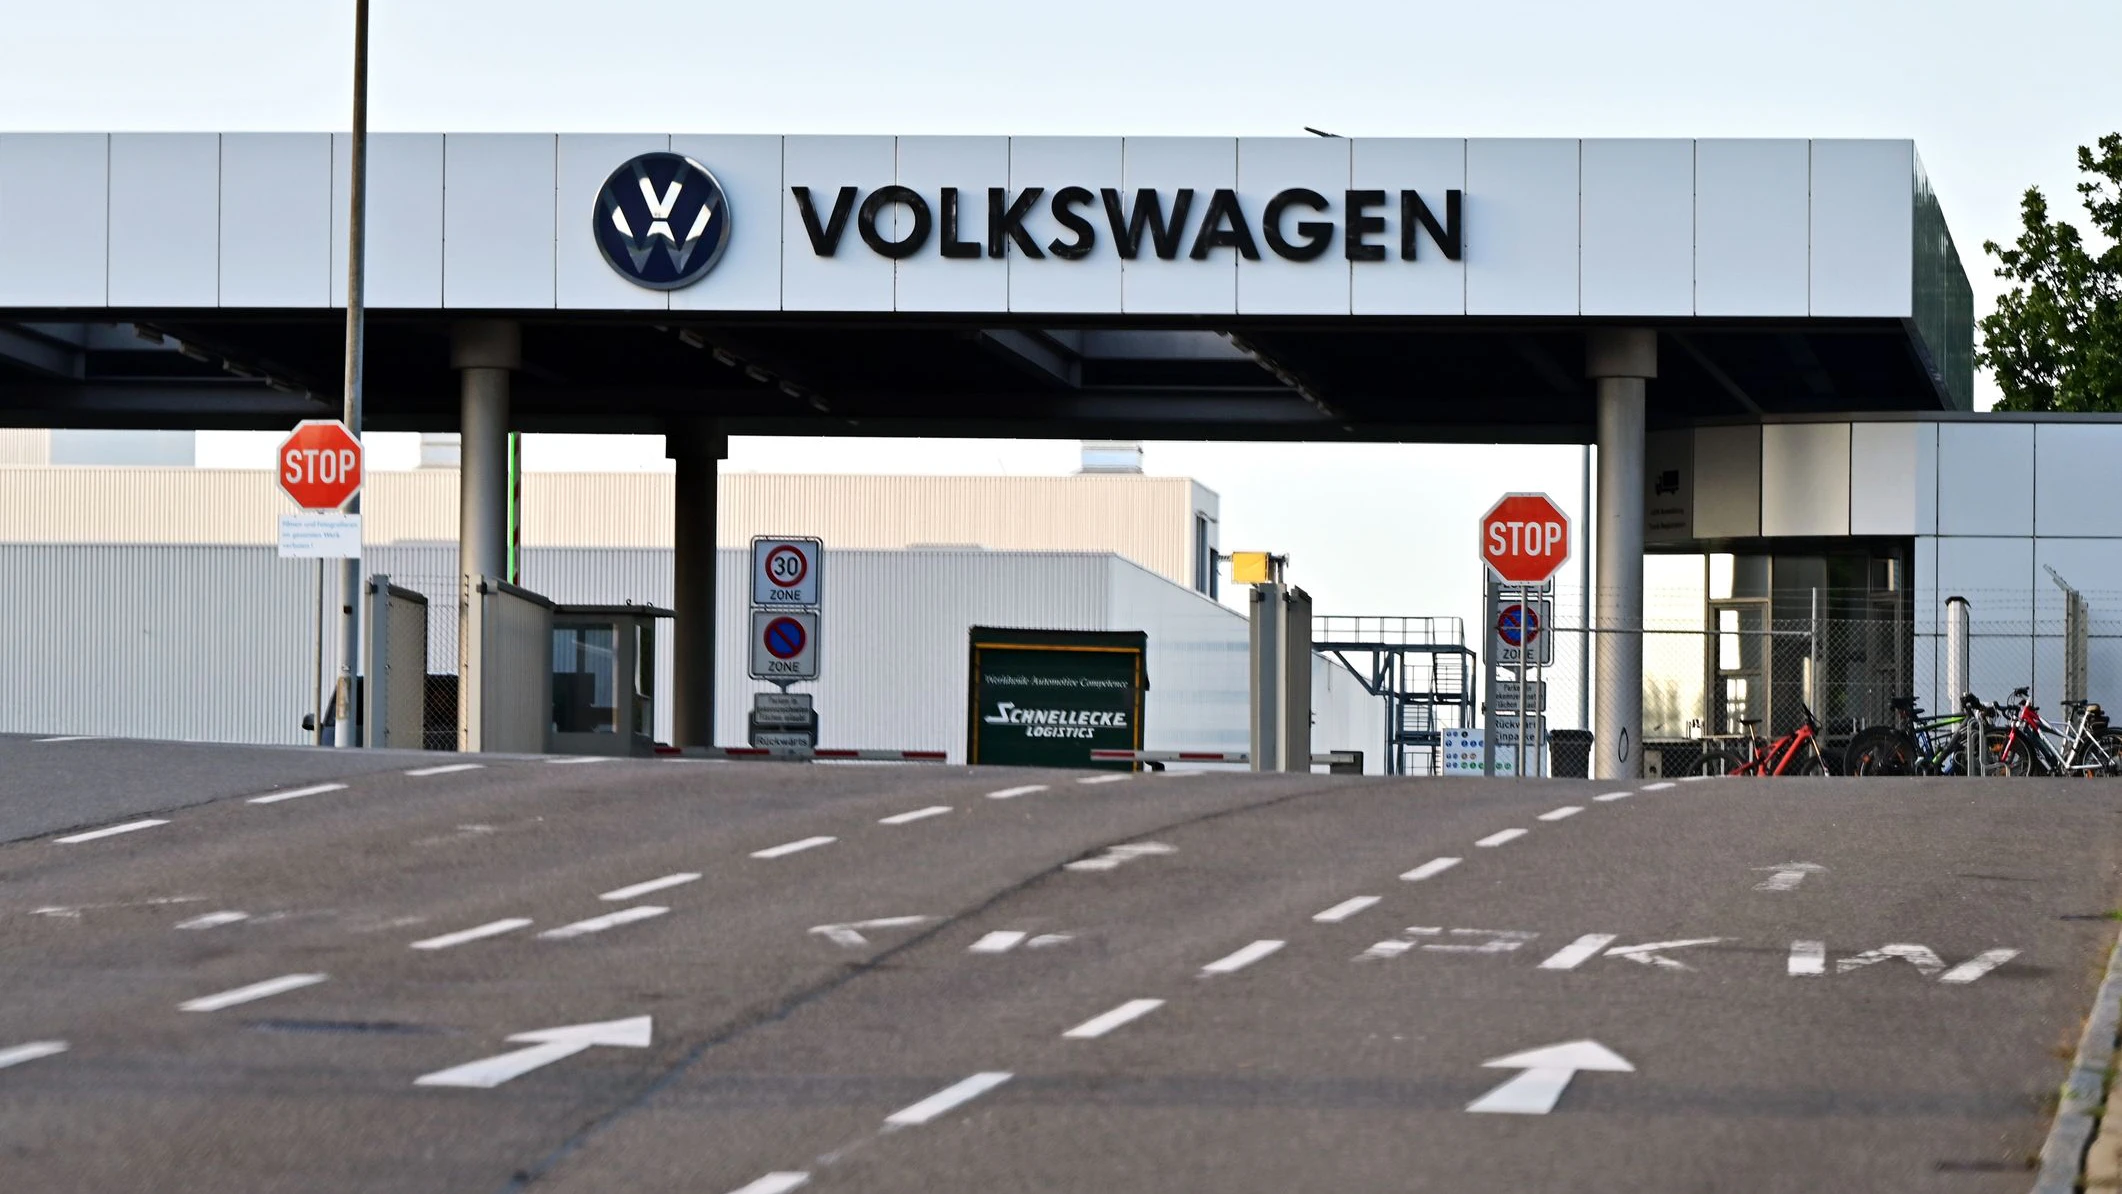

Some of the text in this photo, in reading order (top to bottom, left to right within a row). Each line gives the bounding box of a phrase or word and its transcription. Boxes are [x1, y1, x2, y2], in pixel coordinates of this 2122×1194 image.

[791, 184, 1462, 262] VOLKSWAGEN
[285, 448, 356, 484] STOP
[1488, 521, 1562, 556] STOP
[773, 556, 799, 576] 30
[769, 589, 801, 600] ZONE
[1503, 649, 1534, 660] ZOE
[768, 660, 801, 672] ZONE
[984, 673, 1128, 689] Worldwide Automotive Competence
[984, 701, 1128, 727] SCHNELLECKE
[1026, 726, 1095, 738] LOGISTICS
